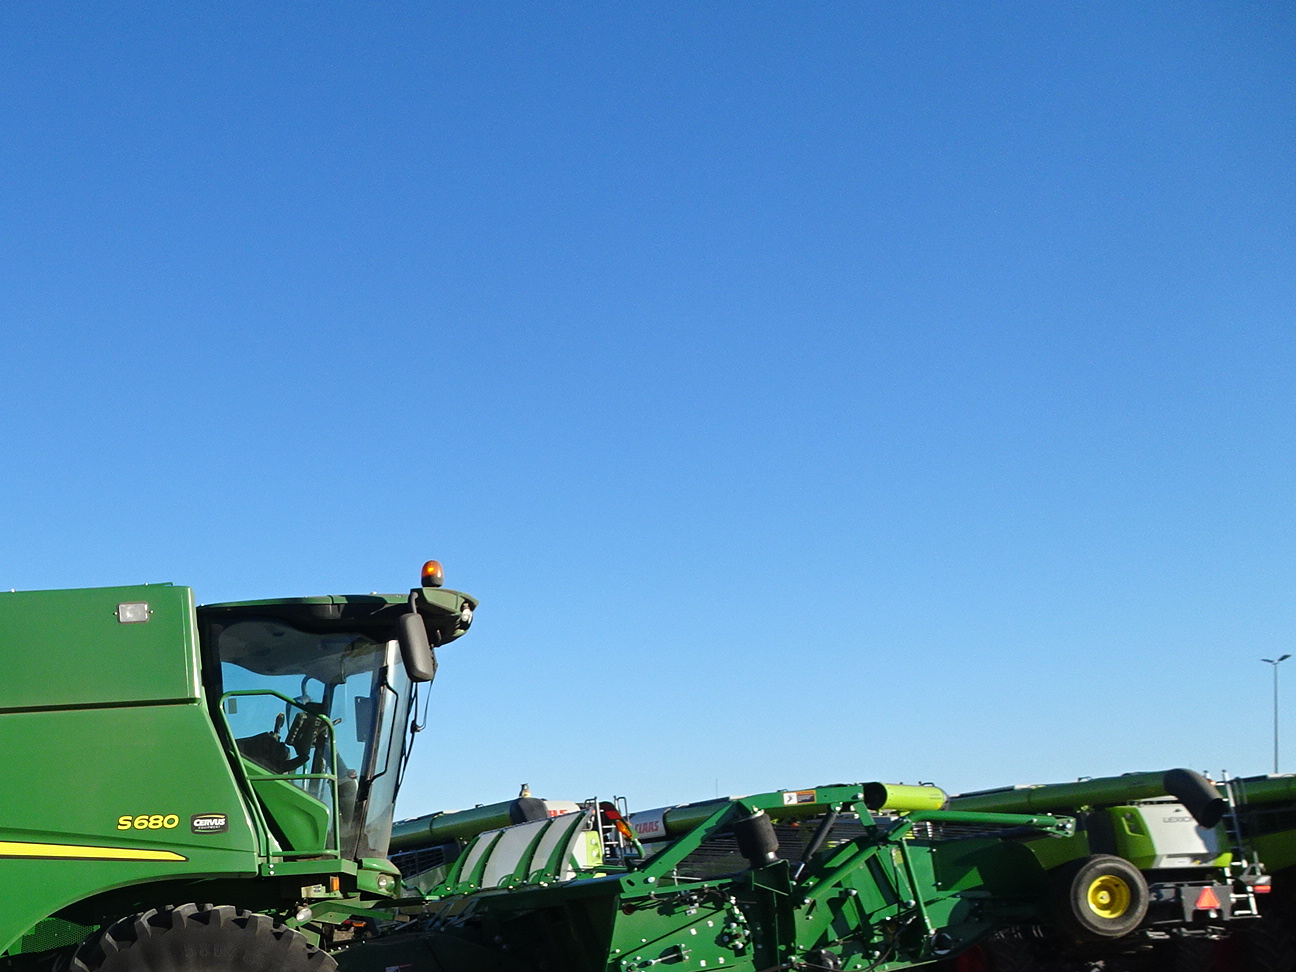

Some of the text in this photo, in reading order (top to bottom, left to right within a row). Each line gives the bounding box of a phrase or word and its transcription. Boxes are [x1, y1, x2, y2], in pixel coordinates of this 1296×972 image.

[117, 814, 179, 830] S680
[193, 818, 226, 827] CERVUS
[635, 820, 659, 834] CLAAS
